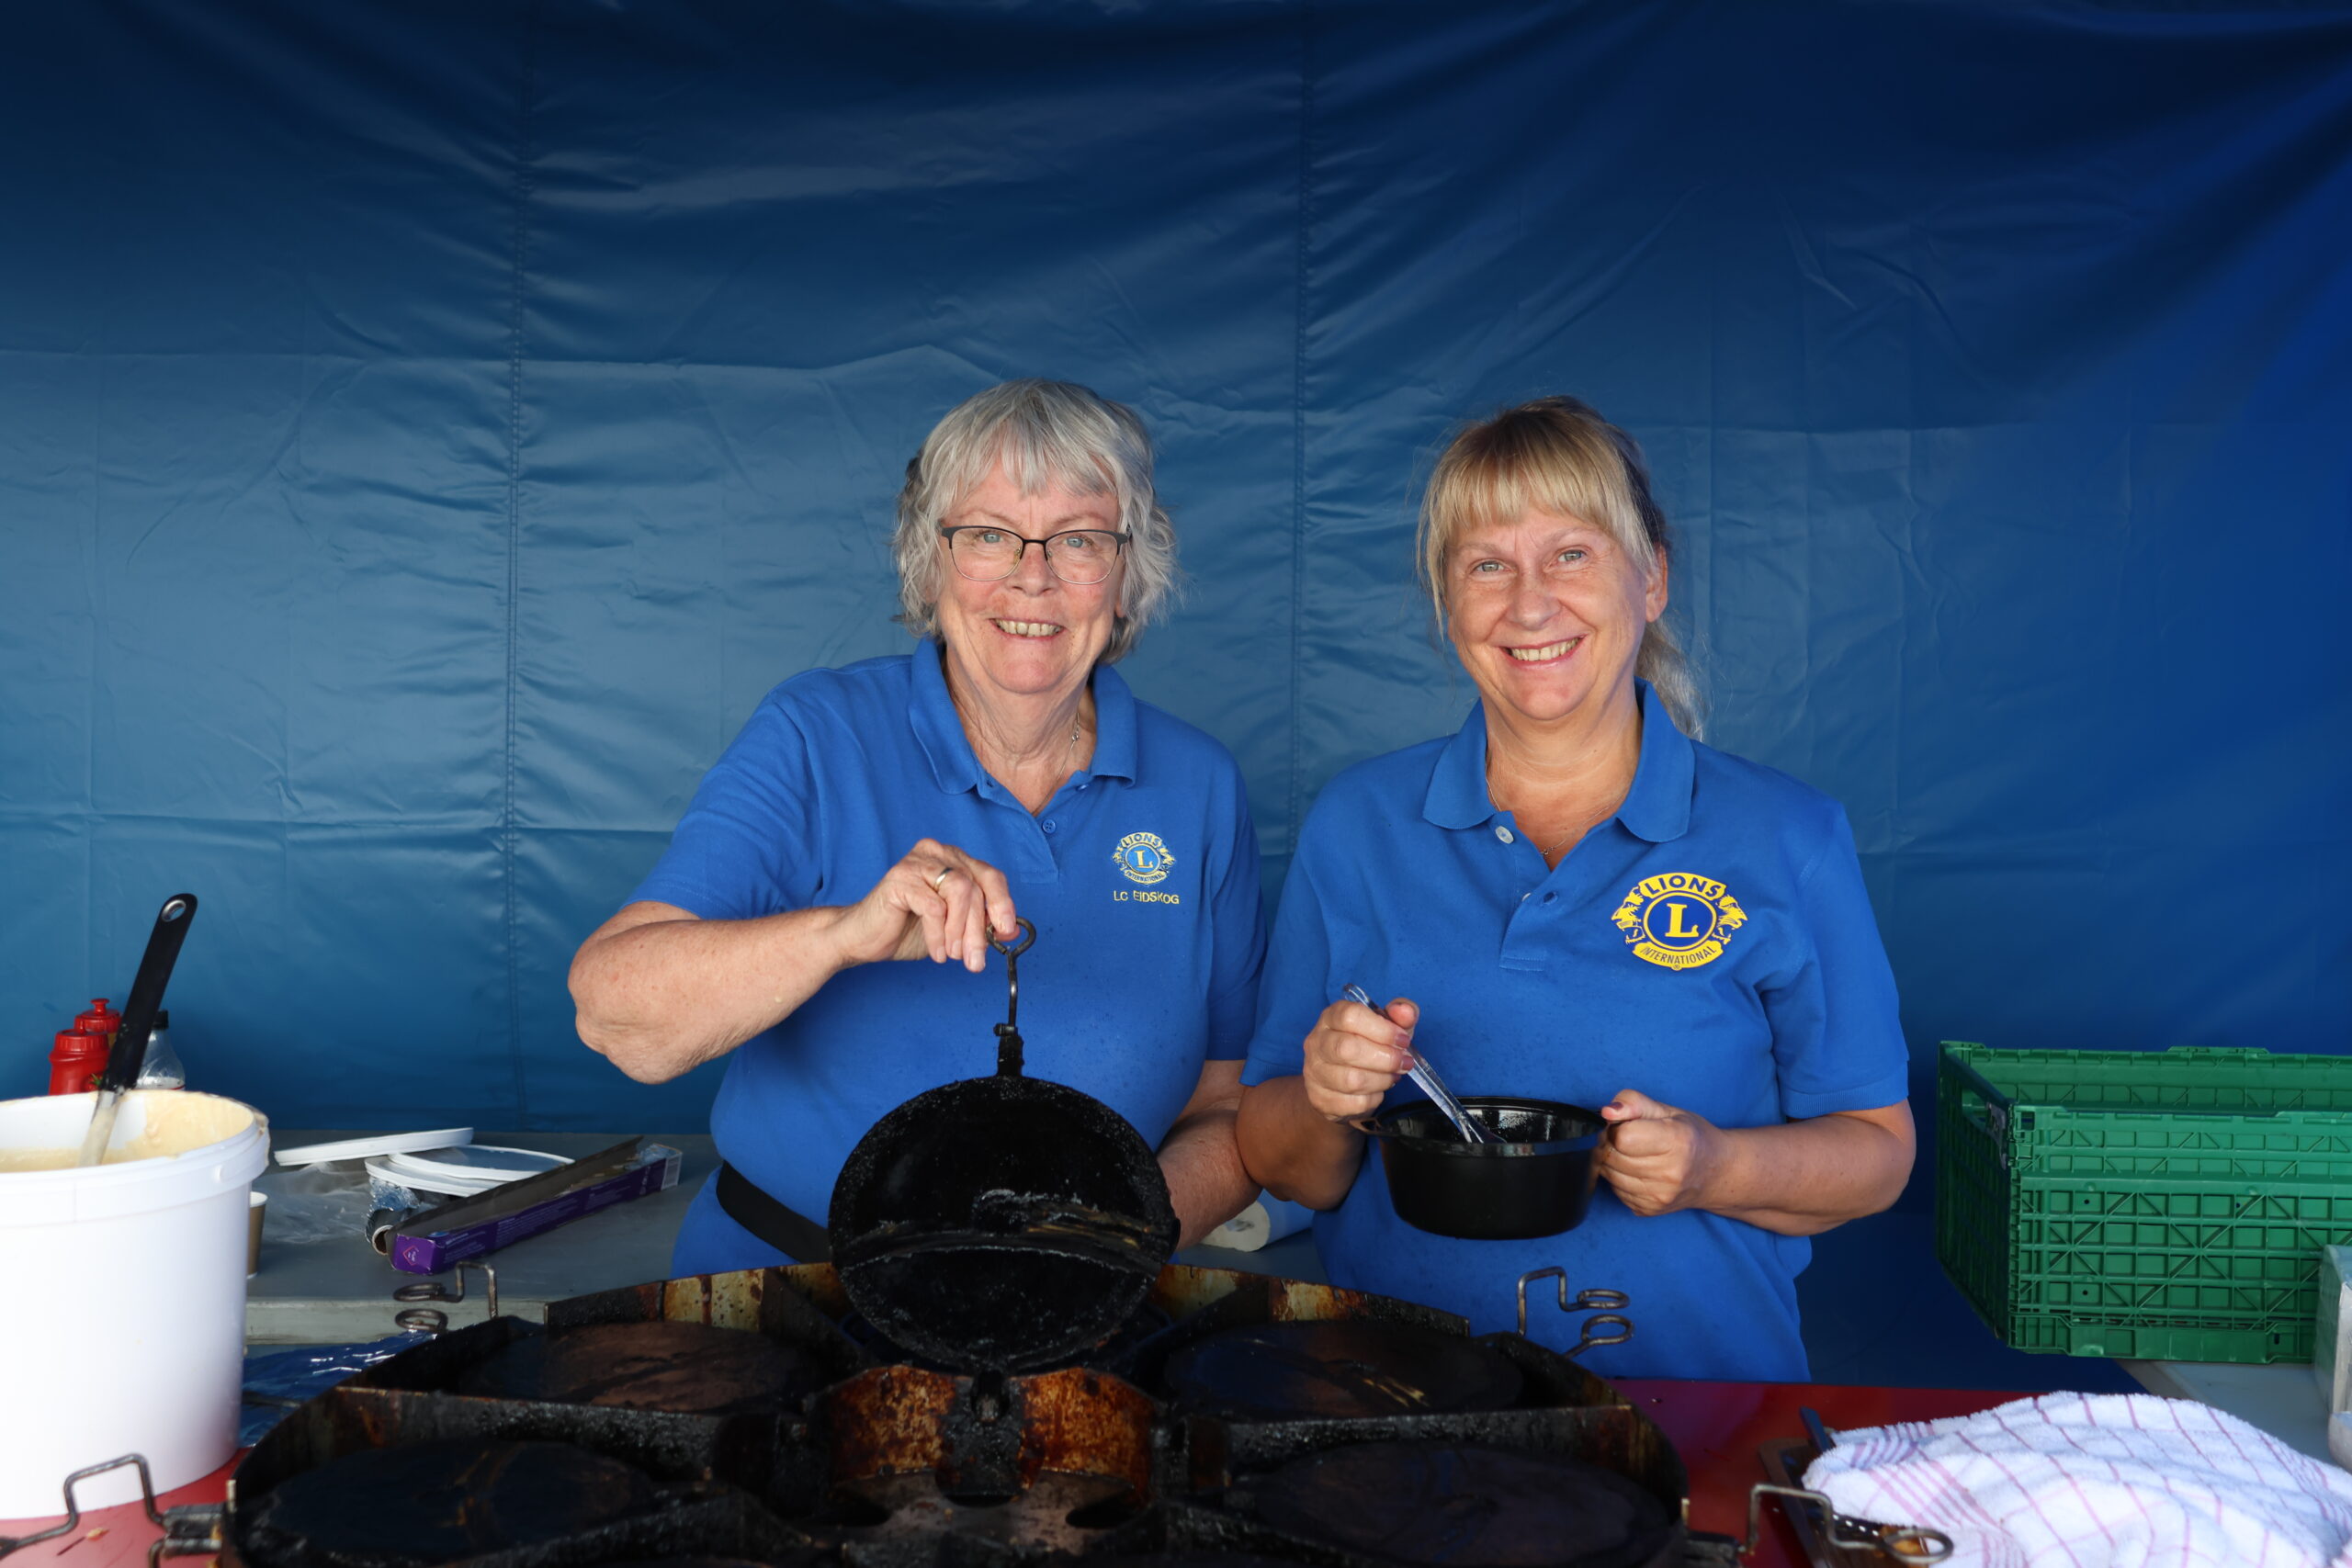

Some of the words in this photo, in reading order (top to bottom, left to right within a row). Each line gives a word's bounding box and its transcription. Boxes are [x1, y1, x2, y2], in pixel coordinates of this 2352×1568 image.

[1122, 833, 1161, 847] LIONS
[1134, 850, 1154, 869] L
[1645, 874, 1722, 897] LIONS
[1114, 890, 1129, 901] LC
[1133, 889, 1180, 905] EIDSKOG
[1665, 903, 1699, 938] L
[1639, 945, 1717, 965] INTERNATIONAL
